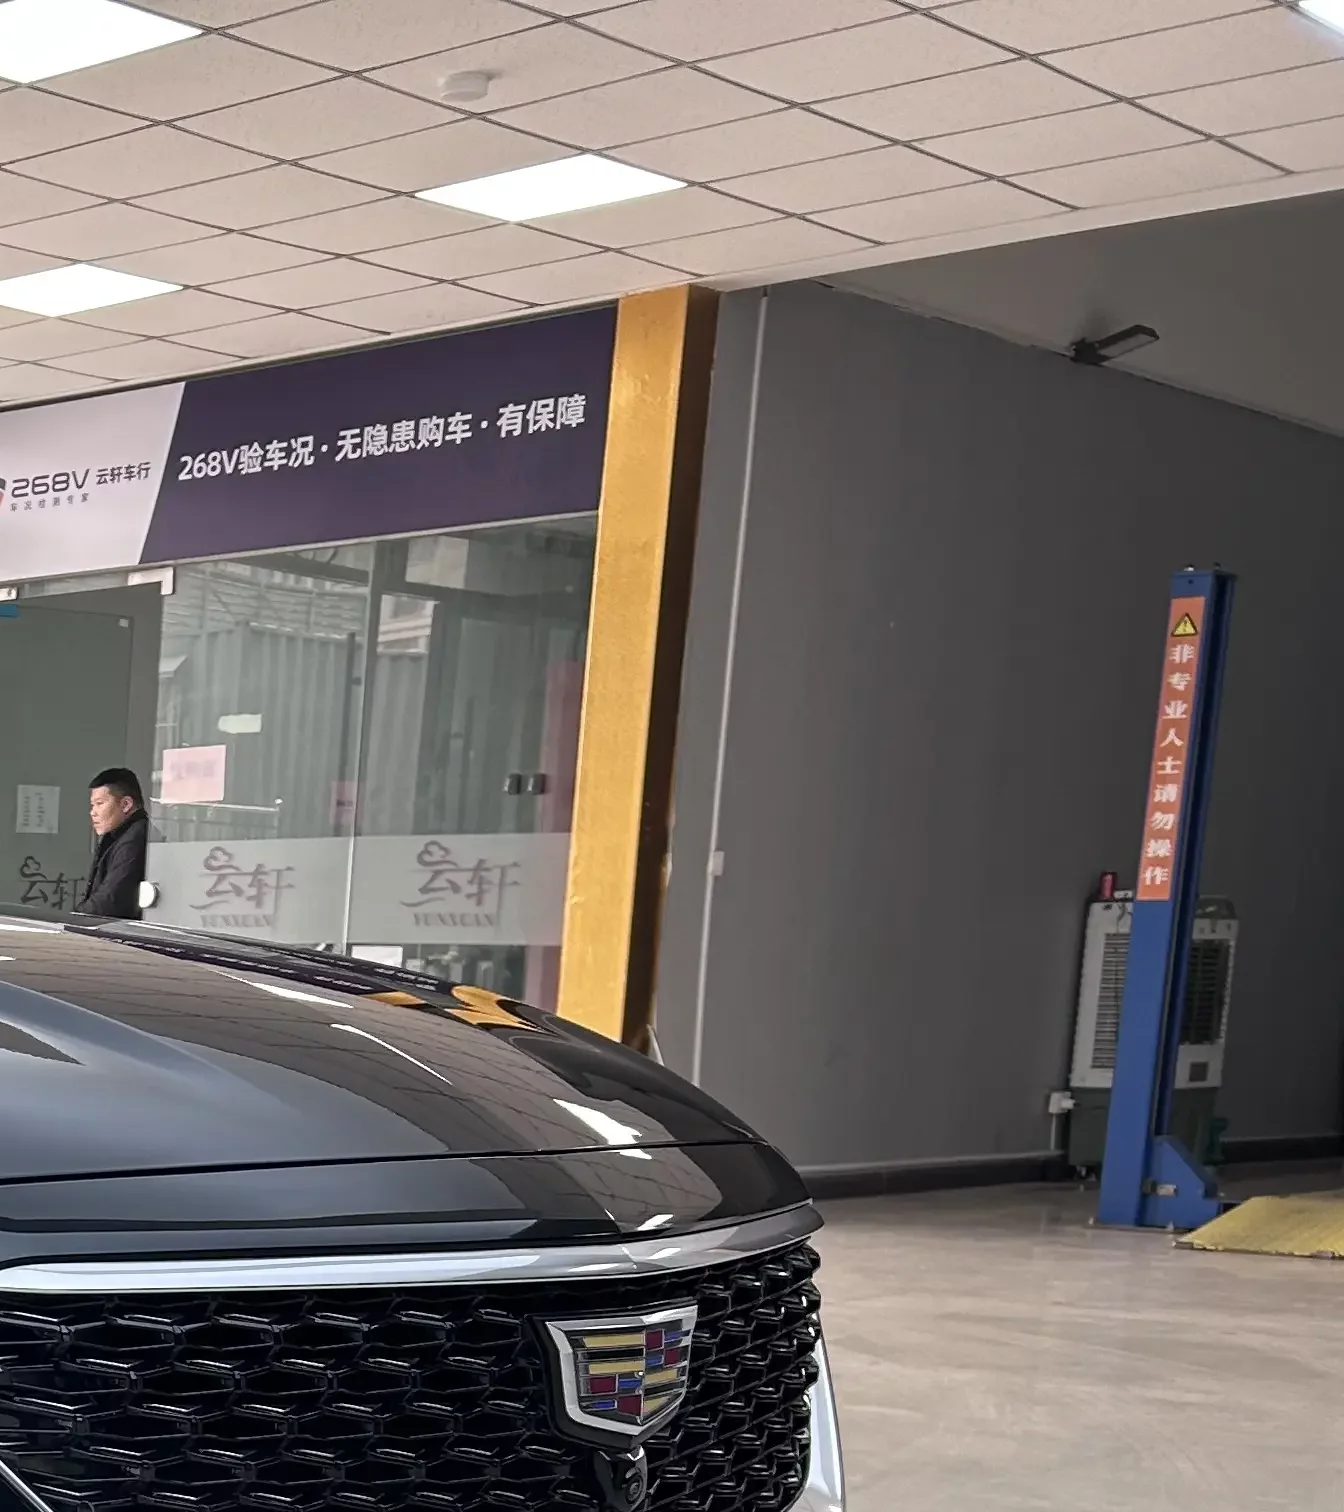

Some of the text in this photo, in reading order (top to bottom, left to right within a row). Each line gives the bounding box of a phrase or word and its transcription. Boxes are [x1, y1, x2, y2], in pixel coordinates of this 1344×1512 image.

[11, 461, 151, 498] 268V 云轩车行
[1144, 643, 1196, 886] 非专业人士请勿操作
